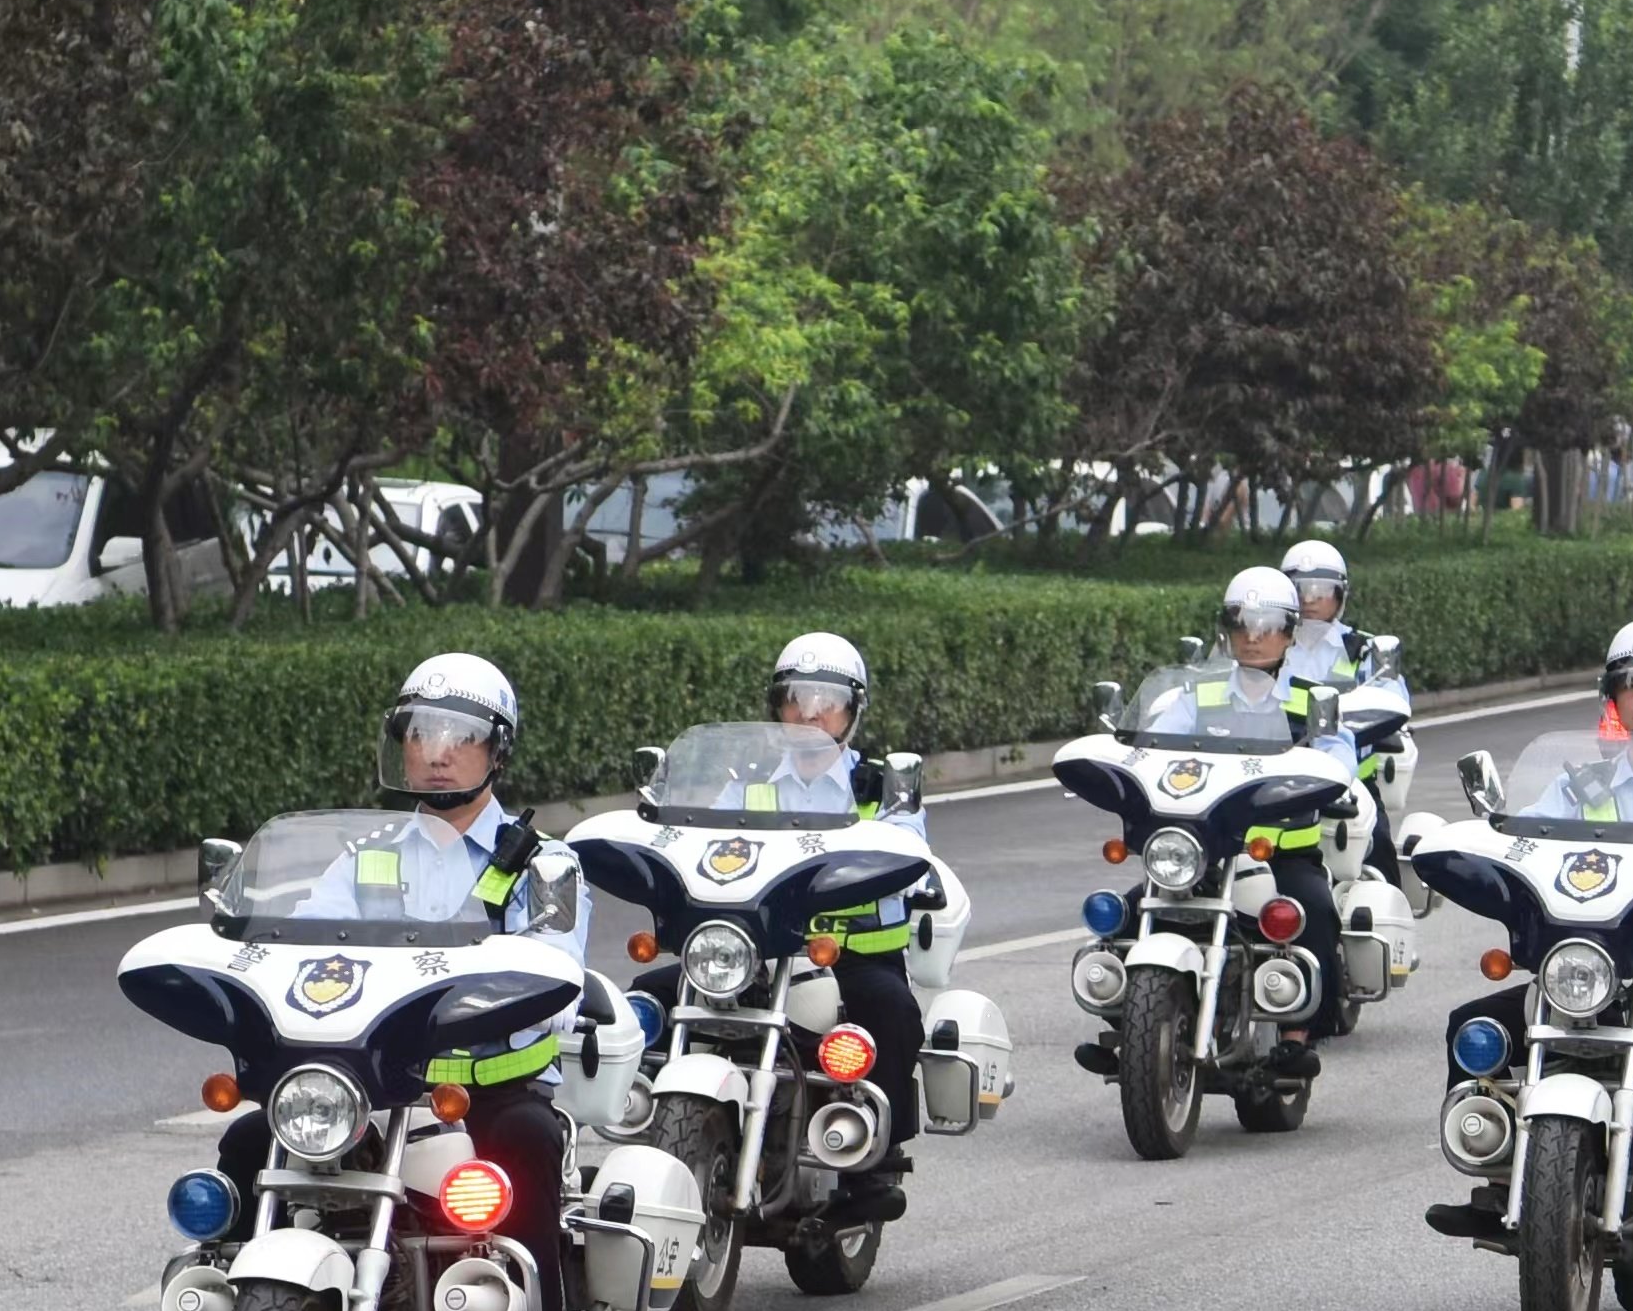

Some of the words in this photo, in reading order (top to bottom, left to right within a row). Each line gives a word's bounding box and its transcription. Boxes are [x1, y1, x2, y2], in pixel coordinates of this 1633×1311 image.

[1505, 835, 1539, 862] 警
[228, 941, 271, 972] 警
[412, 950, 451, 976] 察
